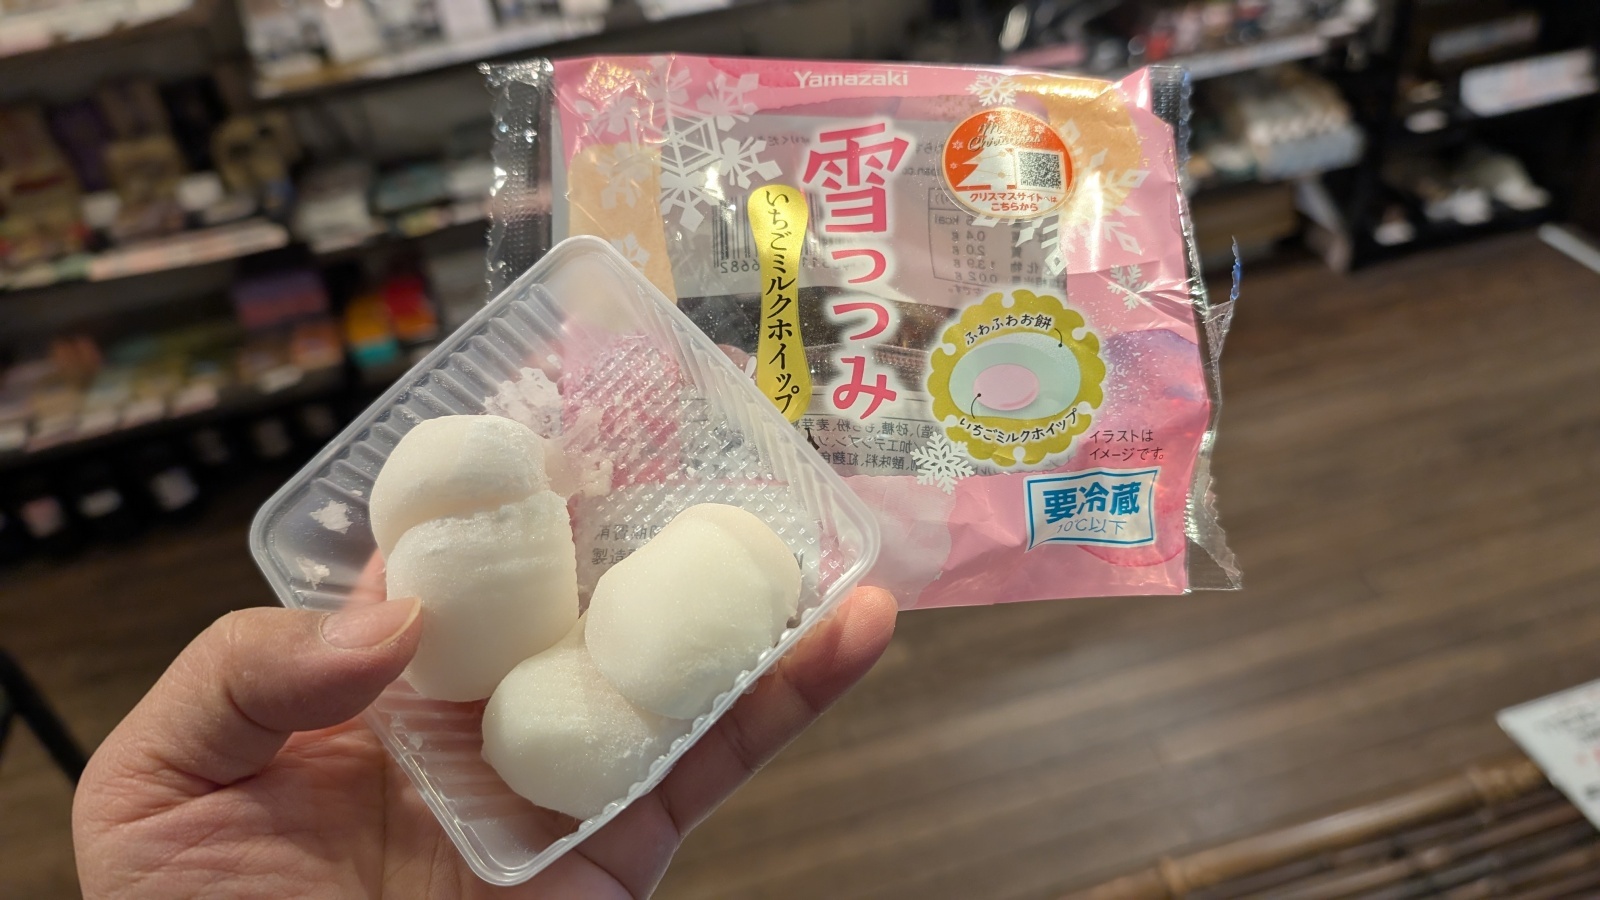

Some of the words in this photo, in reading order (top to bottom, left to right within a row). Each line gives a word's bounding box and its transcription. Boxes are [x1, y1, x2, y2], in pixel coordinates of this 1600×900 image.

[793, 69, 909, 89] Yamazaki
[970, 192, 1057, 203] クリスマスサイトへは
[991, 202, 1039, 212] こちらから
[802, 122, 909, 420] 雪つつみ
[765, 190, 800, 414] いちごミルクホイップ
[964, 313, 1052, 346] ふわふわお餅
[959, 407, 1078, 444] いちごミルクホイップ
[1089, 429, 1154, 444] イラストは
[1089, 446, 1164, 462] イメージです。
[1043, 481, 1142, 525] 要冷蔵
